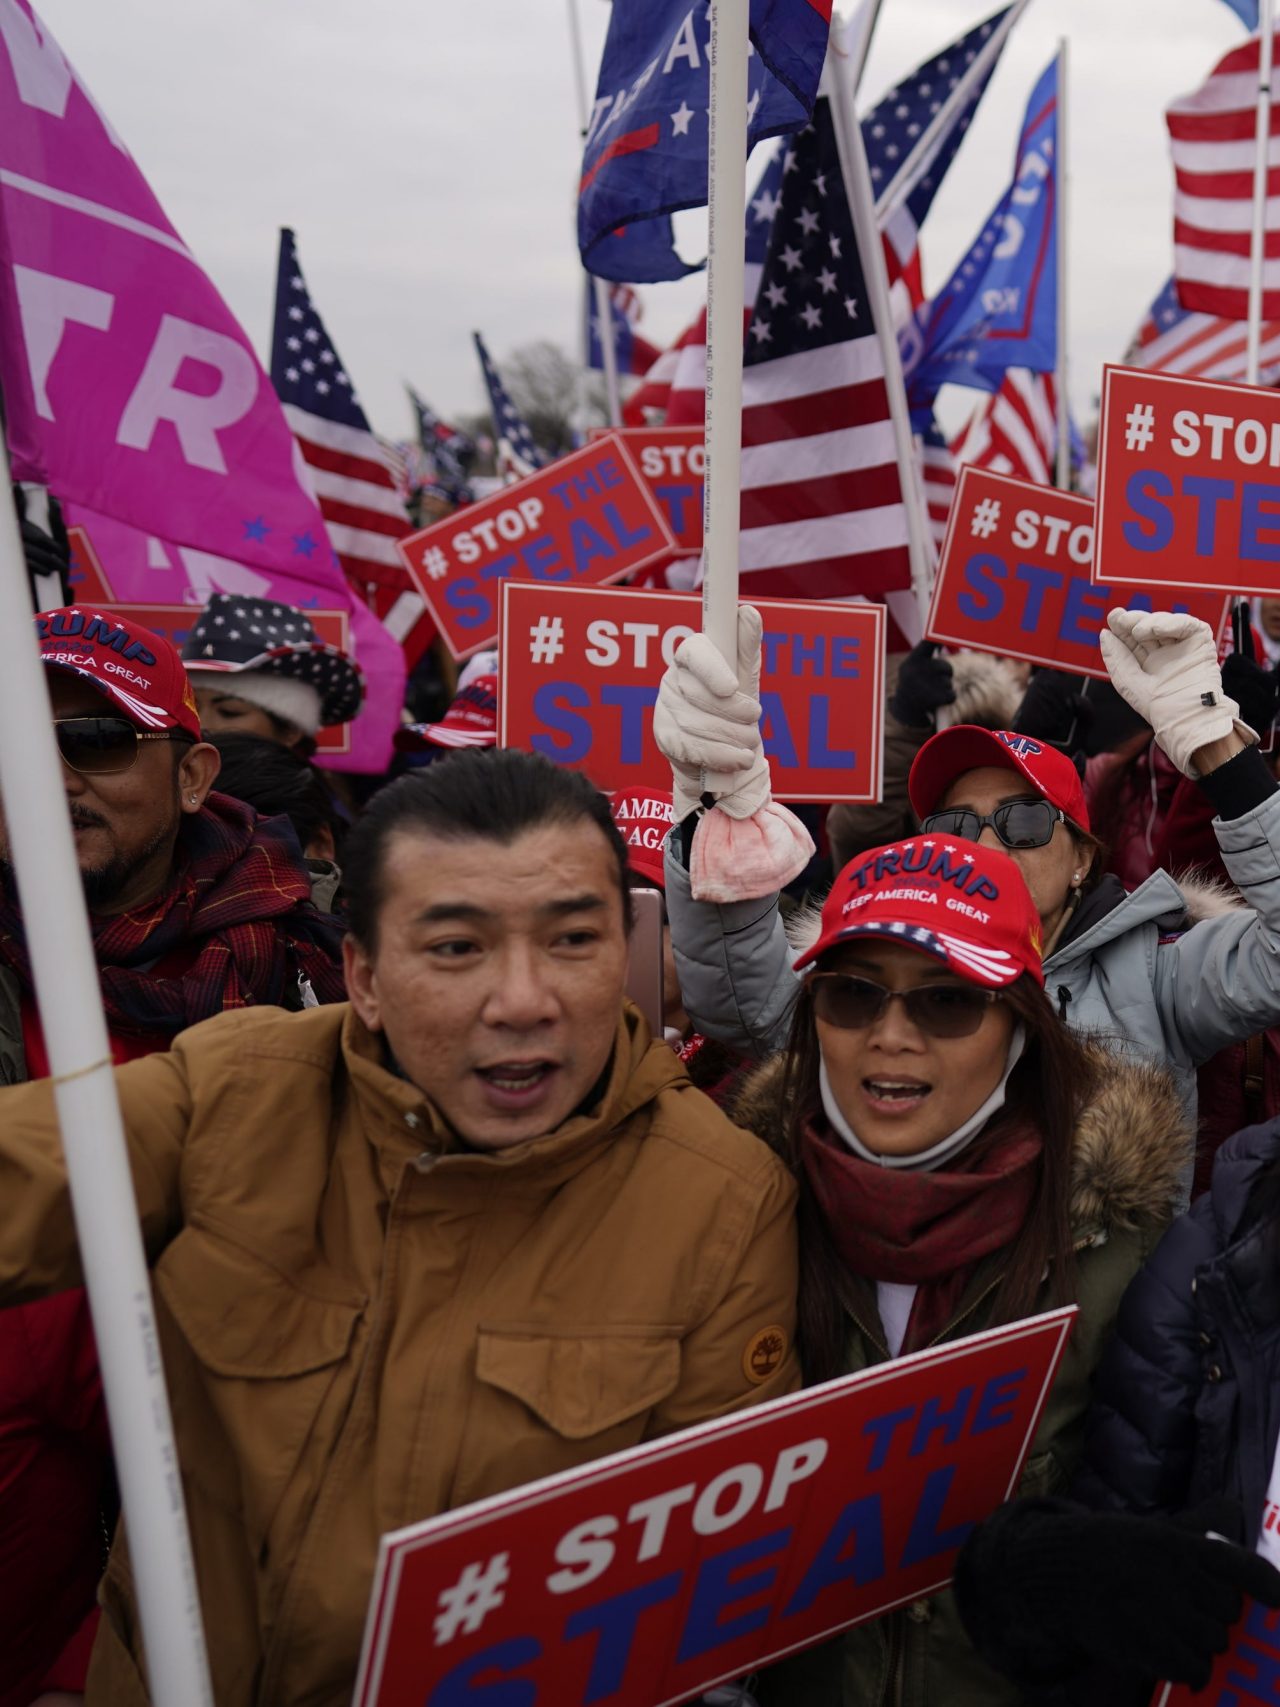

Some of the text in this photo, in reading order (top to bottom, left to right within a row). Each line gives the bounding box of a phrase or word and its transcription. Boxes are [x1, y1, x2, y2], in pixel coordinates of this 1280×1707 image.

[641, 444, 705, 478] STO
[451, 497, 545, 564] STOP
[549, 457, 625, 512] THE
[1011, 508, 1094, 565] STO
[957, 553, 1190, 648] STE
[35, 614, 157, 666] RUMP
[586, 621, 700, 669] STO
[760, 631, 861, 679] THE
[40, 652, 152, 690] MERICA GREAT
[530, 681, 858, 770] STAL
[615, 798, 676, 825] AMER
[848, 845, 999, 900] TRUMP
[842, 888, 991, 925] KEEP AMERICA GREAT
[546, 1438, 828, 1594] STOP
[861, 1369, 1030, 1472] THE
[423, 1466, 985, 1707] STEAL
